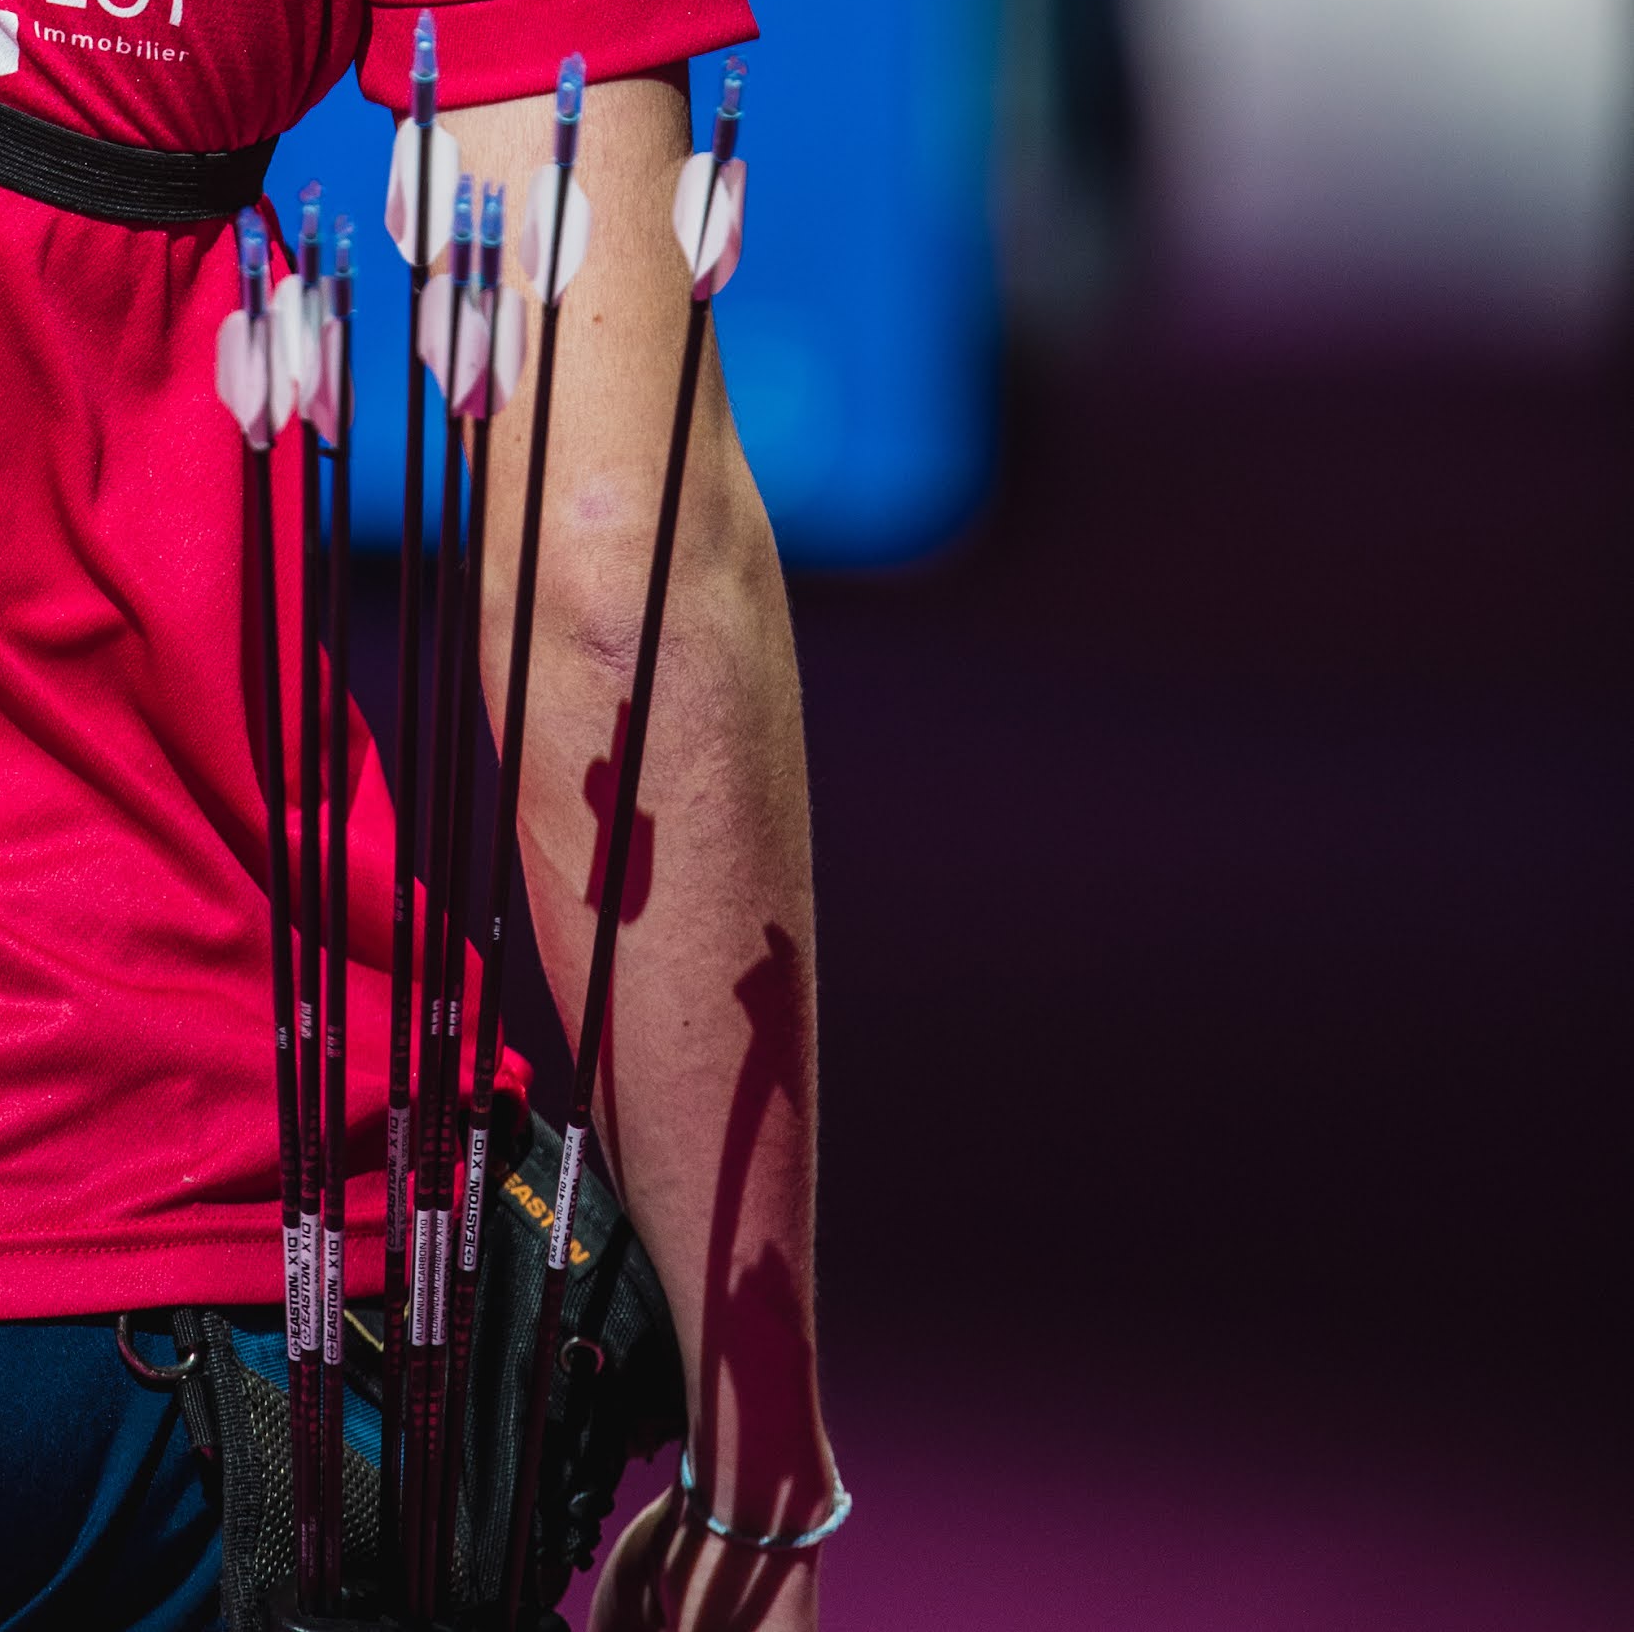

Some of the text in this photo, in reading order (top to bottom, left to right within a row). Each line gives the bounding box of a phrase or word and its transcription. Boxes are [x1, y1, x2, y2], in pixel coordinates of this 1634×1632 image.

[467, 1138, 485, 1243] EASTON X10
[287, 1236, 300, 1340] EASTON X10
[301, 1222, 312, 1325] EASTON X10
[327, 1240, 340, 1339] EASTON X10
[416, 1218, 429, 1341] ALUMINUM/CARBON/X10
